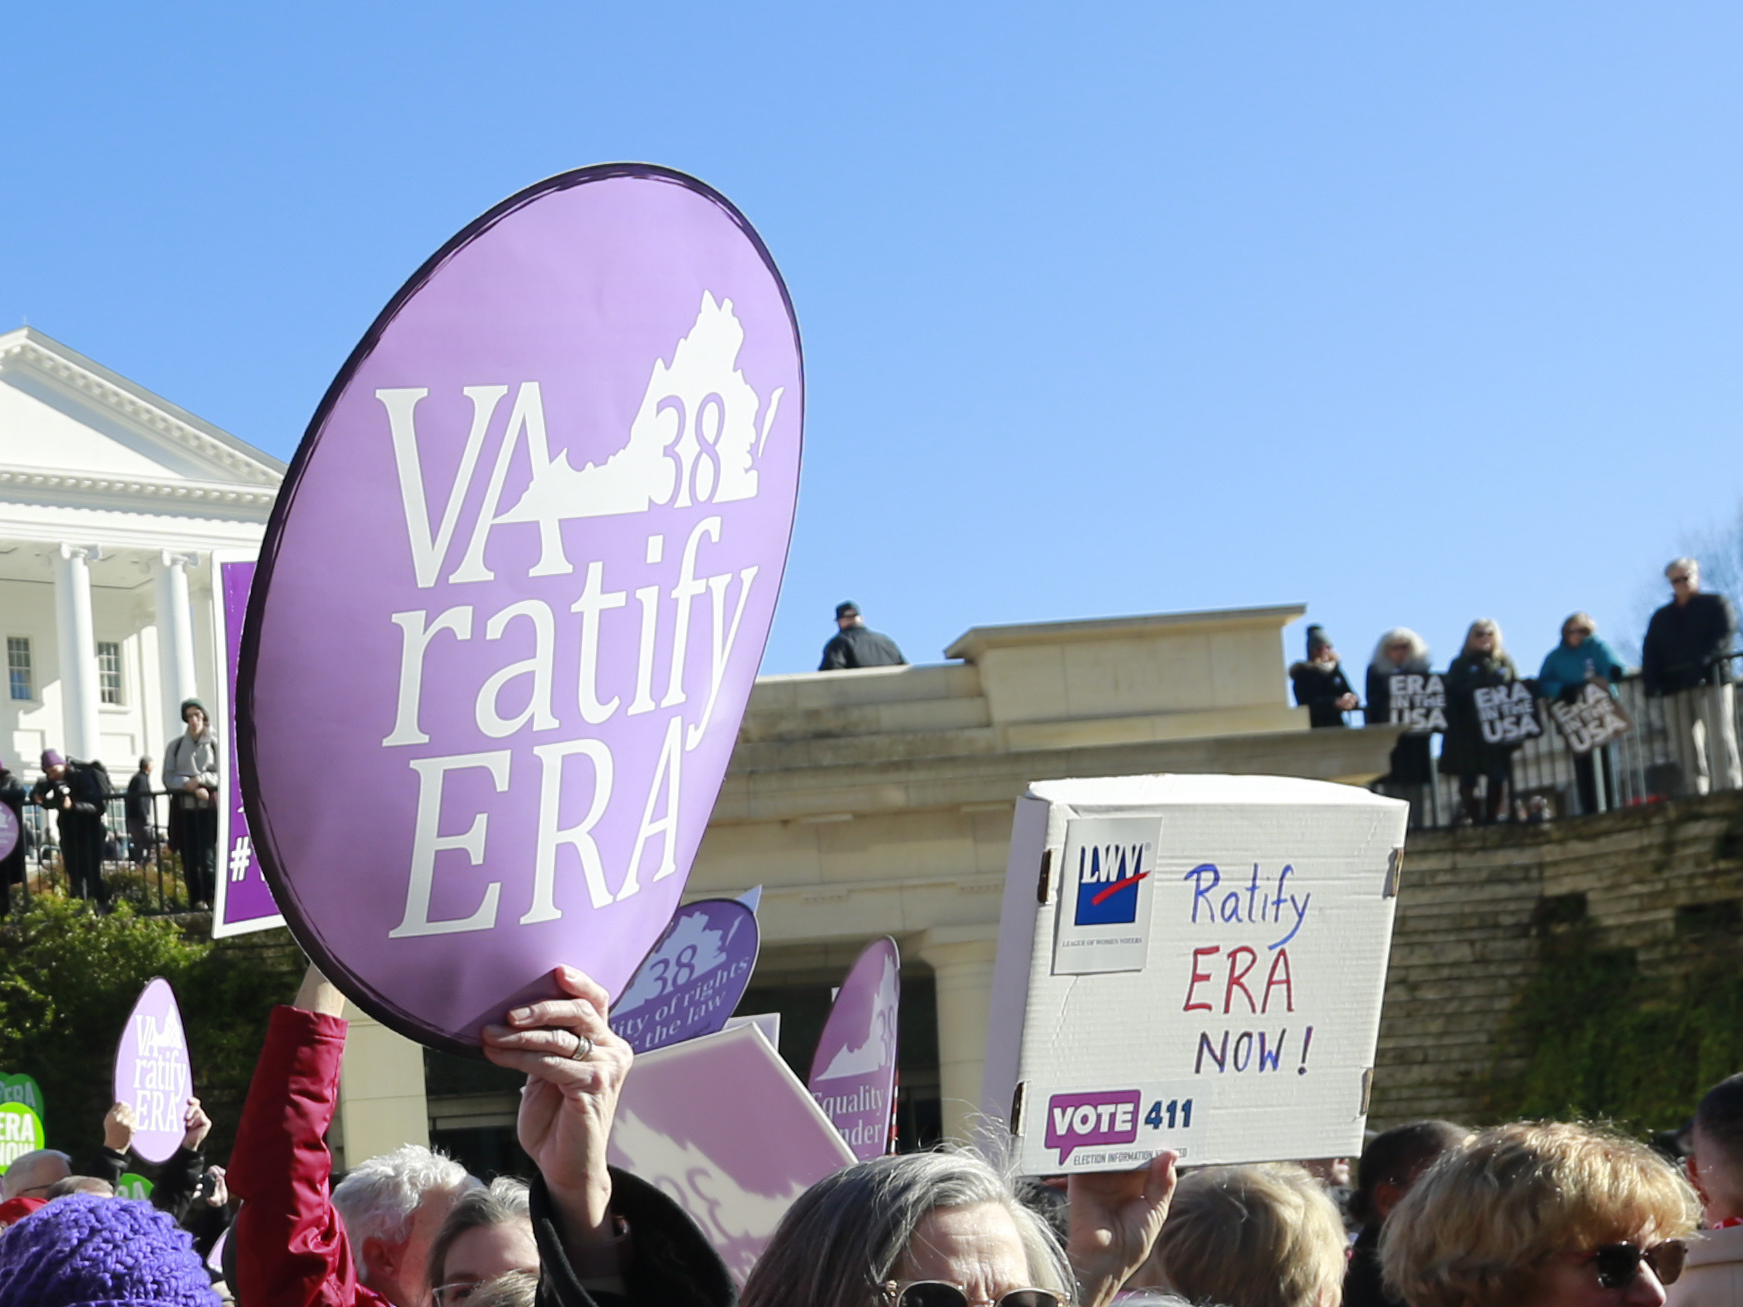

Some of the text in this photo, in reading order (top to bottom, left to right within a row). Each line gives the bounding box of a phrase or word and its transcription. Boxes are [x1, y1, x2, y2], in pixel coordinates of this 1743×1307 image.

[655, 392, 724, 504] 38
[375, 381, 575, 589] VA
[382, 517, 758, 751] ratify
[1389, 675, 1446, 695] ERA
[1474, 681, 1532, 708] ERA
[1481, 713, 1542, 743] USA
[1569, 712, 1627, 753] USA
[389, 716, 687, 940] ERA
[1184, 862, 1311, 951] Ratify
[650, 944, 698, 996] 38
[655, 994, 681, 1021] of
[683, 956, 749, 1007] rights
[1183, 945, 1295, 1015] ERA
[136, 1014, 159, 1057] VA
[645, 1019, 682, 1048] the
[687, 991, 727, 1025] law
[133, 1050, 187, 1103] ratify
[135, 1089, 179, 1133] ERA
[838, 1118, 882, 1146] nder
[1053, 1098, 1193, 1136] VOTE 411
